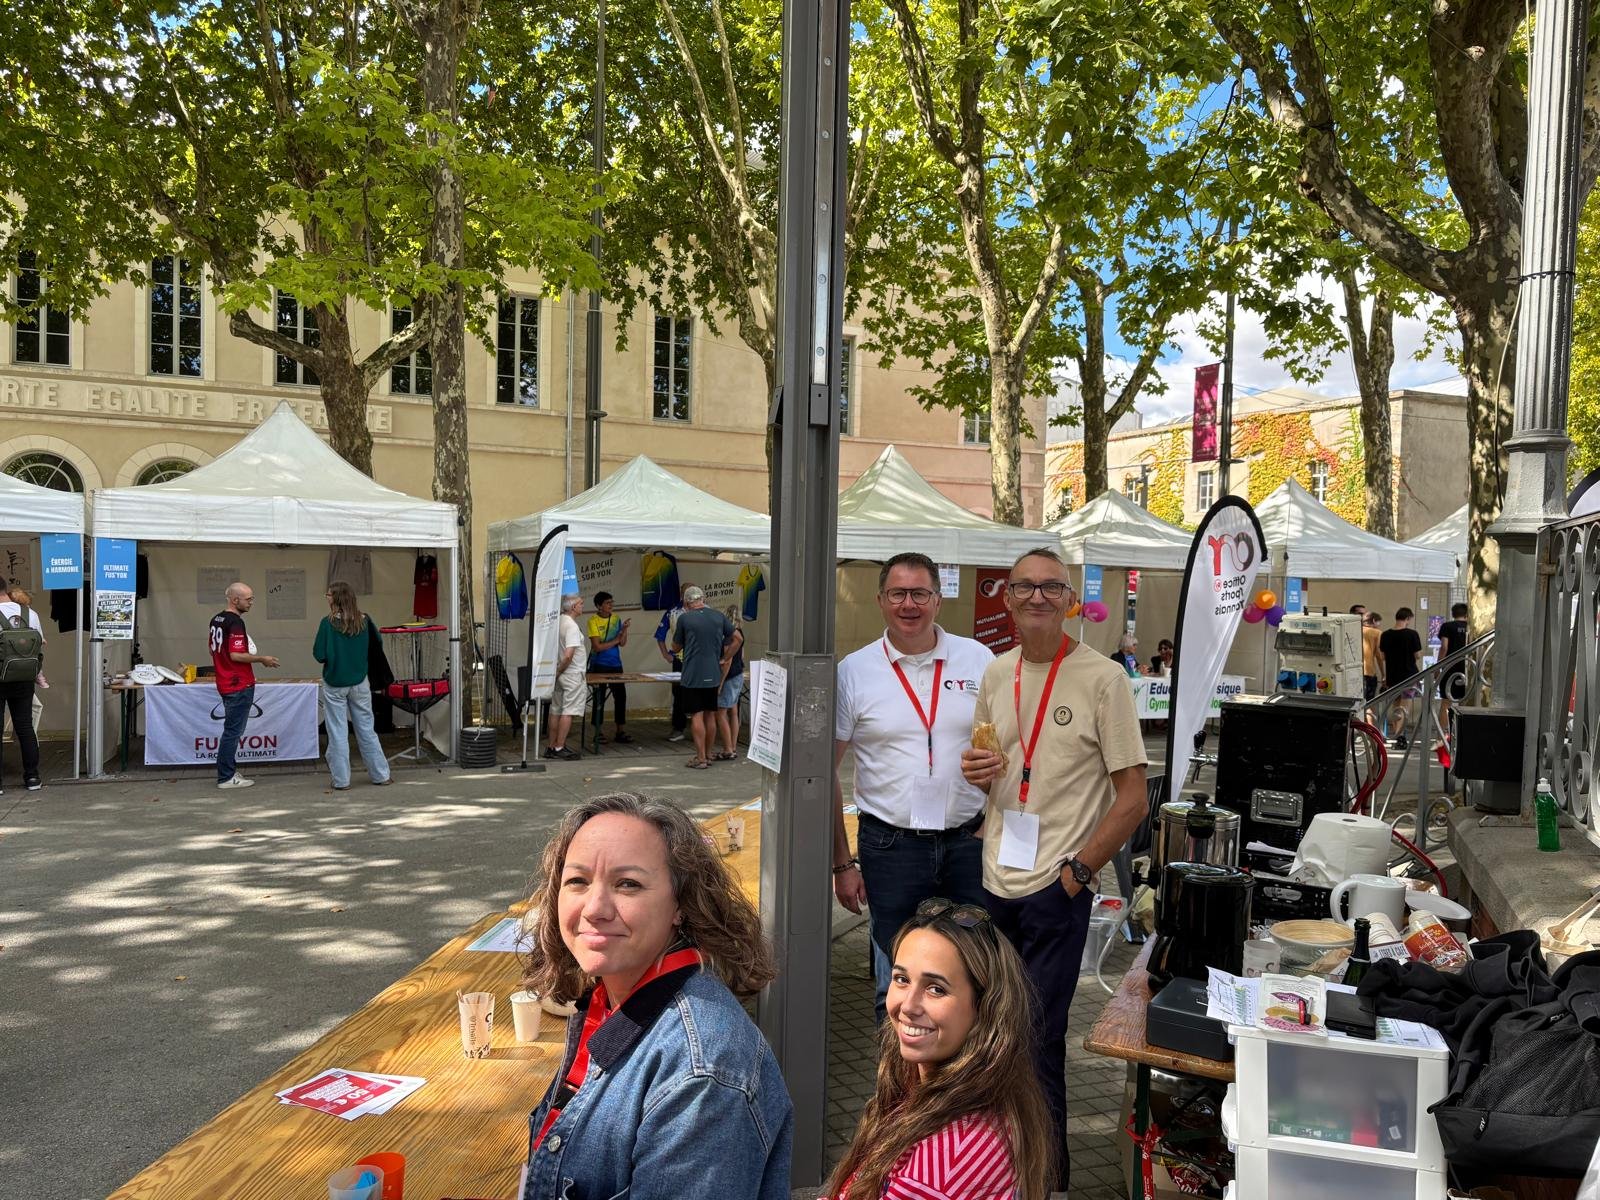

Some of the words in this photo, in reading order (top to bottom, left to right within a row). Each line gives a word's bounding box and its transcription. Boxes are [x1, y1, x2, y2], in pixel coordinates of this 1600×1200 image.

[581, 565, 590, 573] LA
[591, 558, 613, 571] ROCHE
[581, 572, 596, 581] SUR
[976, 612, 1006, 624] MUTUALISER
[210, 625, 223, 653] 39
[237, 750, 277, 758] ULTIMATE
